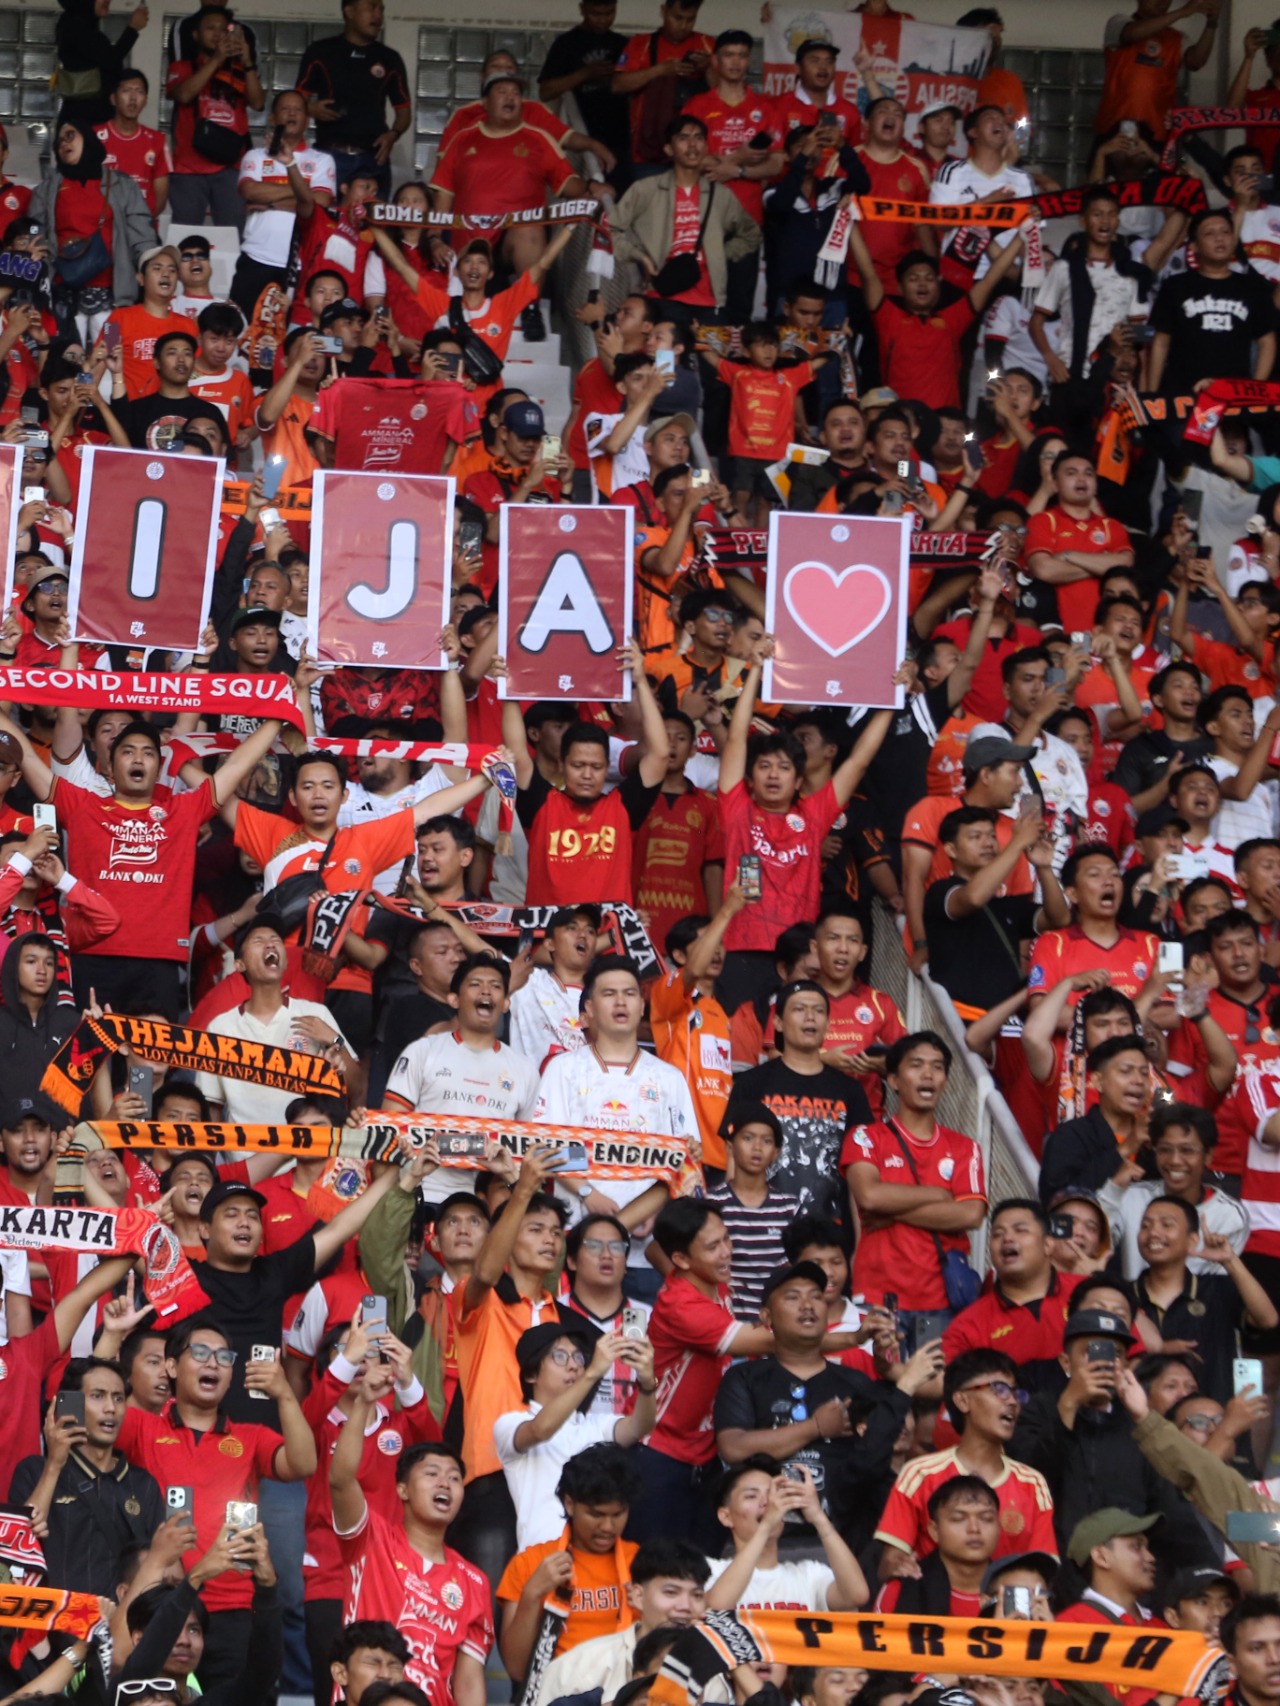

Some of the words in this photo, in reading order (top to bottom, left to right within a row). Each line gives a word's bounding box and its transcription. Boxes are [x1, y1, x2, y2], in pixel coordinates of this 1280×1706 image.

[373, 203, 424, 223] COME
[548, 199, 599, 219] TIGER
[874, 202, 1017, 221] PERSIJA
[127, 497, 167, 600] I
[345, 519, 420, 622] J
[518, 548, 617, 656] A
[131, 674, 204, 697] LINE
[108, 692, 125, 704] 1A
[125, 694, 158, 706] WEST
[160, 695, 202, 708] STAND
[99, 869, 131, 882] BANK
[144, 873, 164, 884] DKI
[143, 1046, 216, 1073] LOYALITAS
[216, 1062, 263, 1083] TANPA
[263, 1072, 307, 1094] BATAS
[442, 1090, 476, 1104] BANK
[486, 1098, 508, 1112] DKI
[120, 1124, 313, 1149] PERSIJA
[593, 1141, 687, 1171] ENDING
[795, 1617, 1175, 1671] PERSIJA
